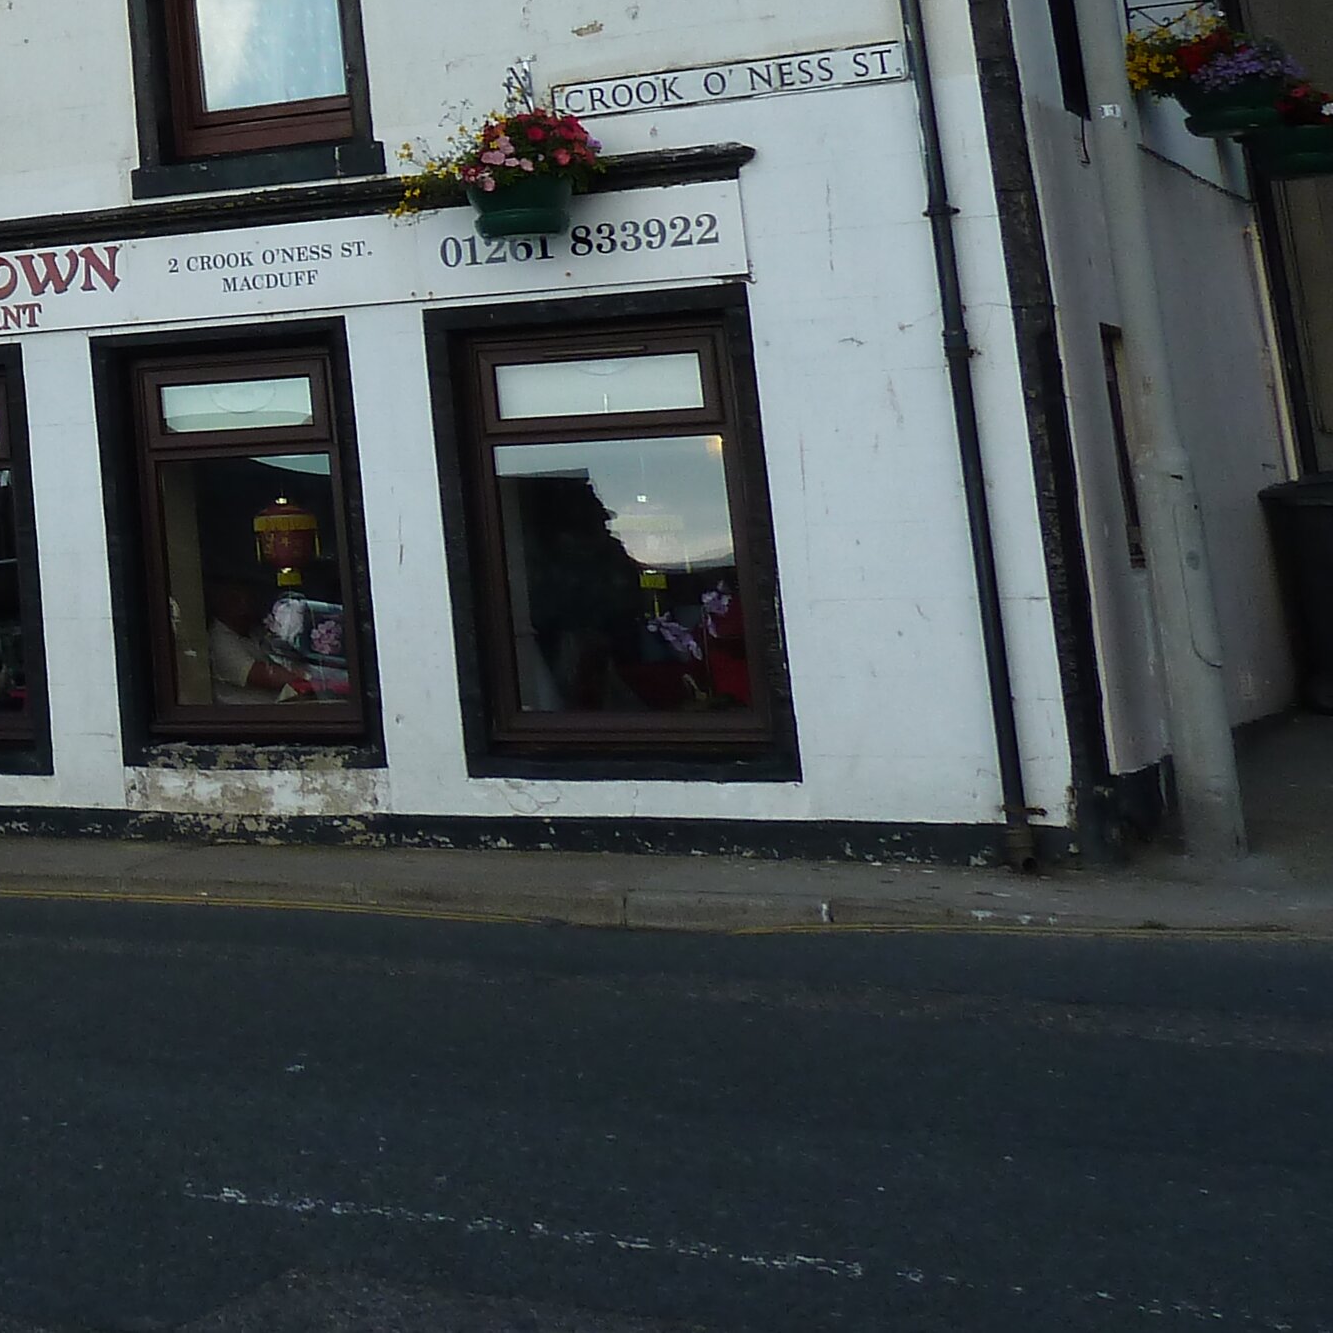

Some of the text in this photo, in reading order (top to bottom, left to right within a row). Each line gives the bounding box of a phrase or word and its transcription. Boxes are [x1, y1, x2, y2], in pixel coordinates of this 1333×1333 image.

[565, 76, 684, 113] CROOK
[748, 57, 834, 91] NESS
[570, 213, 720, 256] 833922
[168, 240, 373, 273] 2 CROOK O'NESS ST.
[222, 269, 319, 293] MACDUFF
